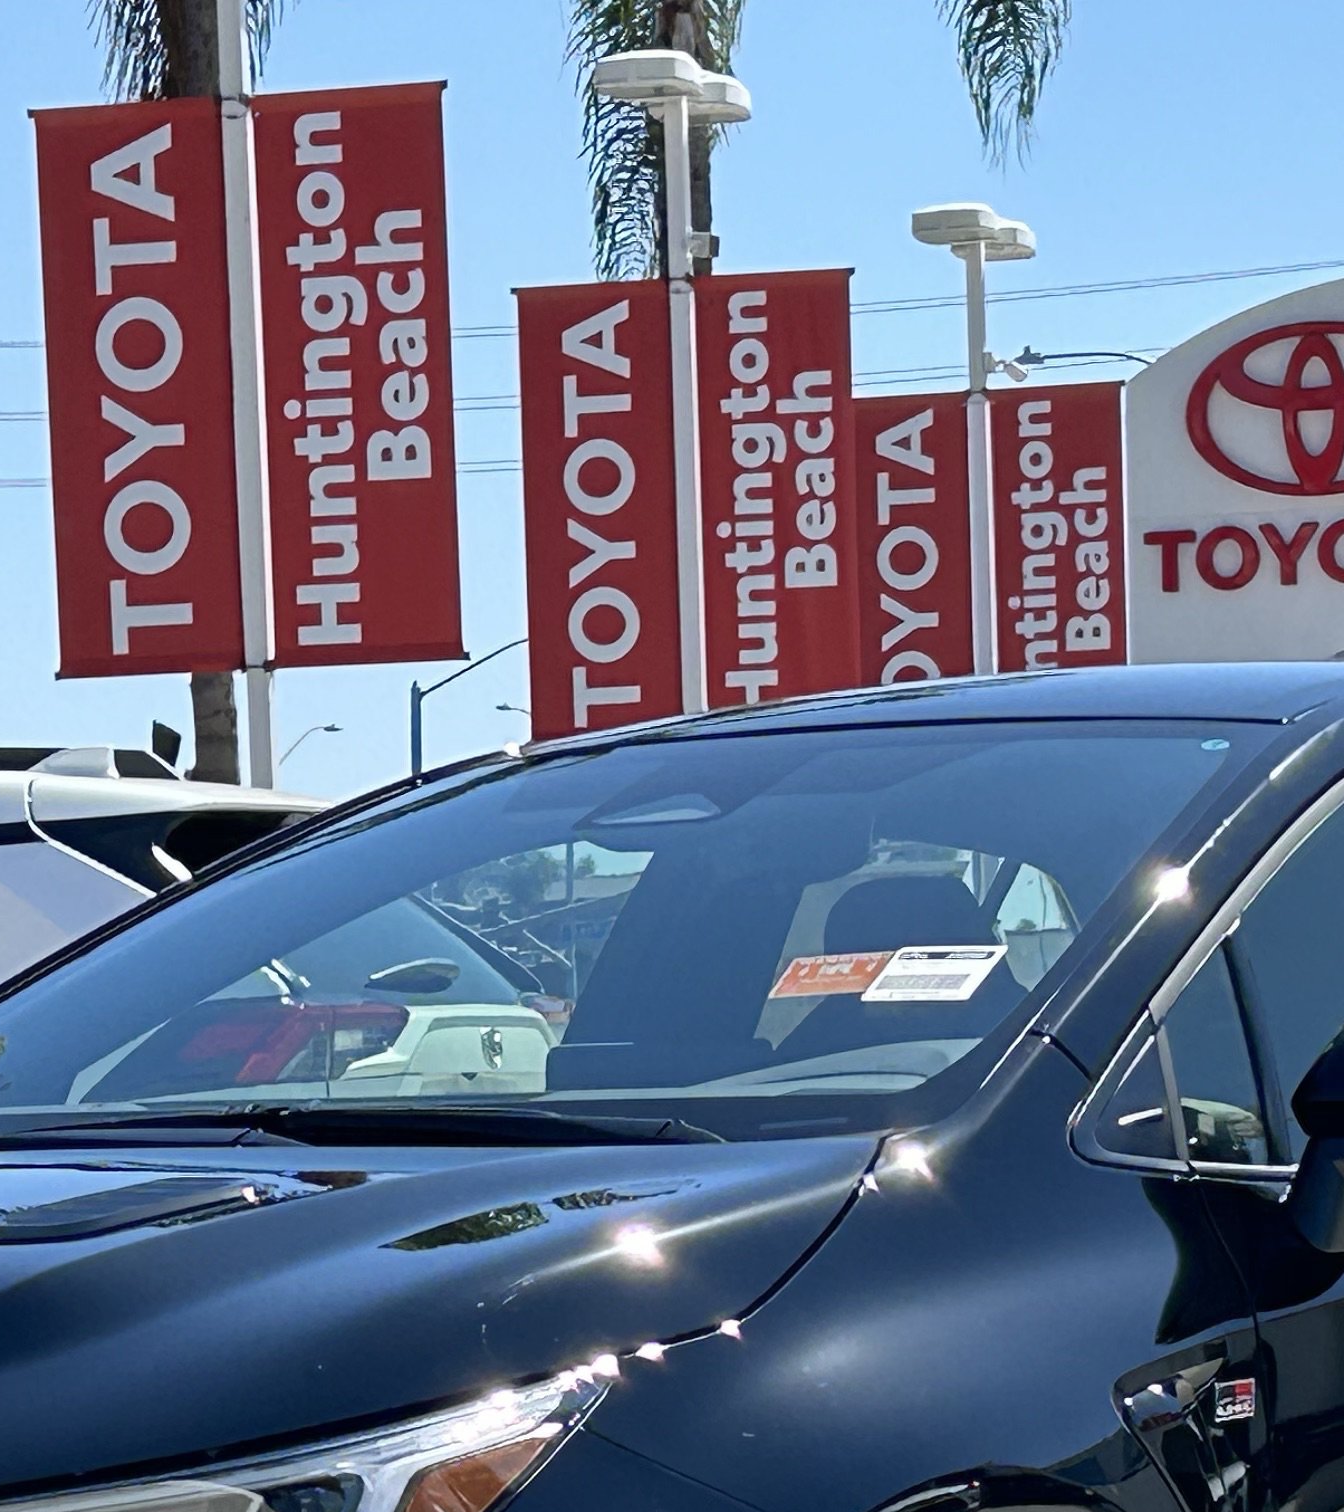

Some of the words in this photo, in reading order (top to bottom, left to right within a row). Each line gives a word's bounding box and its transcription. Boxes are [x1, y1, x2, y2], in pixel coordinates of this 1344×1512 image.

[90, 123, 194, 656] TOYOTA
[284, 111, 368, 646] Huntington
[355, 208, 432, 481] Beach
[561, 299, 642, 729] TOYOTA
[716, 290, 786, 704] Huntington
[776, 370, 838, 588] Beach
[1059, 466, 1111, 652] Beach
